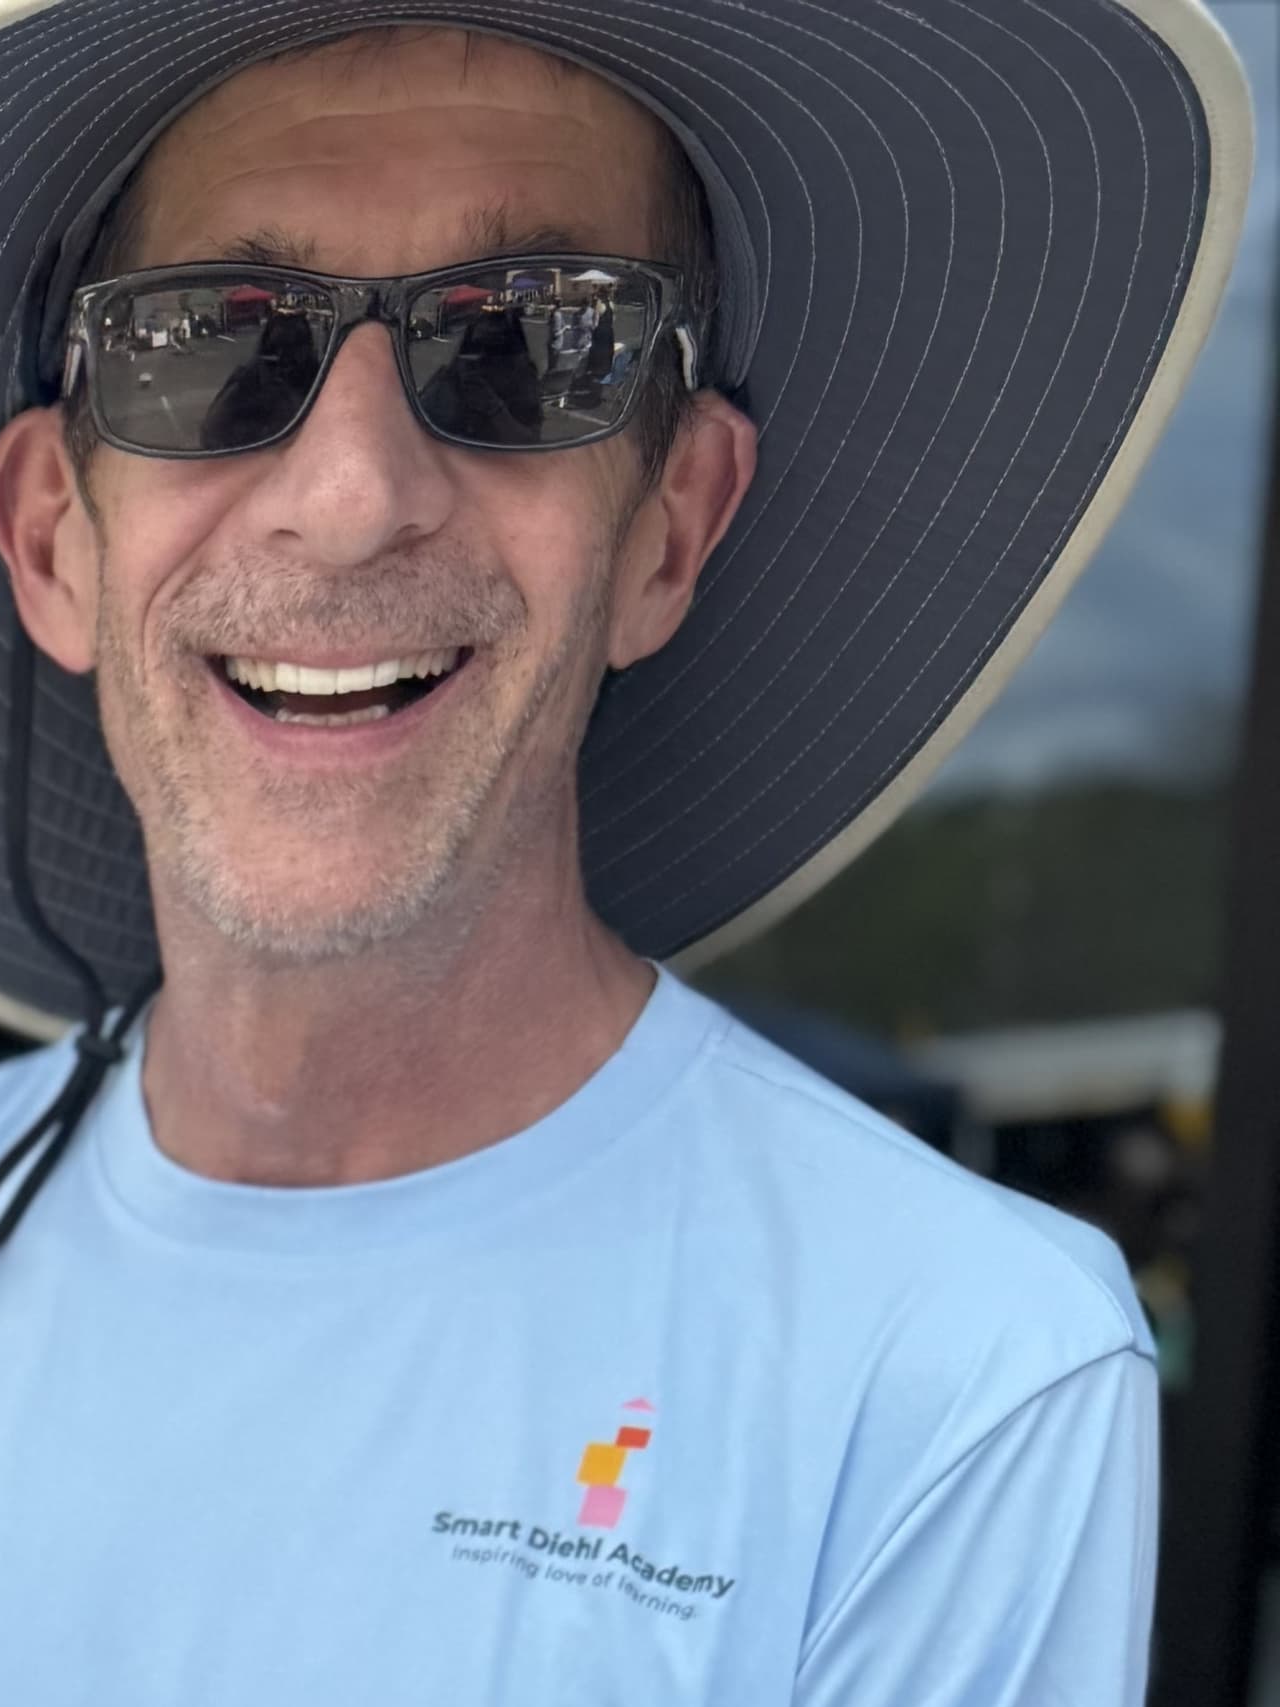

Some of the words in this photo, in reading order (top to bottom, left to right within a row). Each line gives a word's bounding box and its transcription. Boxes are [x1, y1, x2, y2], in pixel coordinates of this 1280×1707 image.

[432, 1511, 520, 1541] Smart
[527, 1526, 603, 1560] Diehl
[606, 1542, 735, 1599] Academy
[545, 1562, 588, 1584] love
[592, 1571, 614, 1587] of
